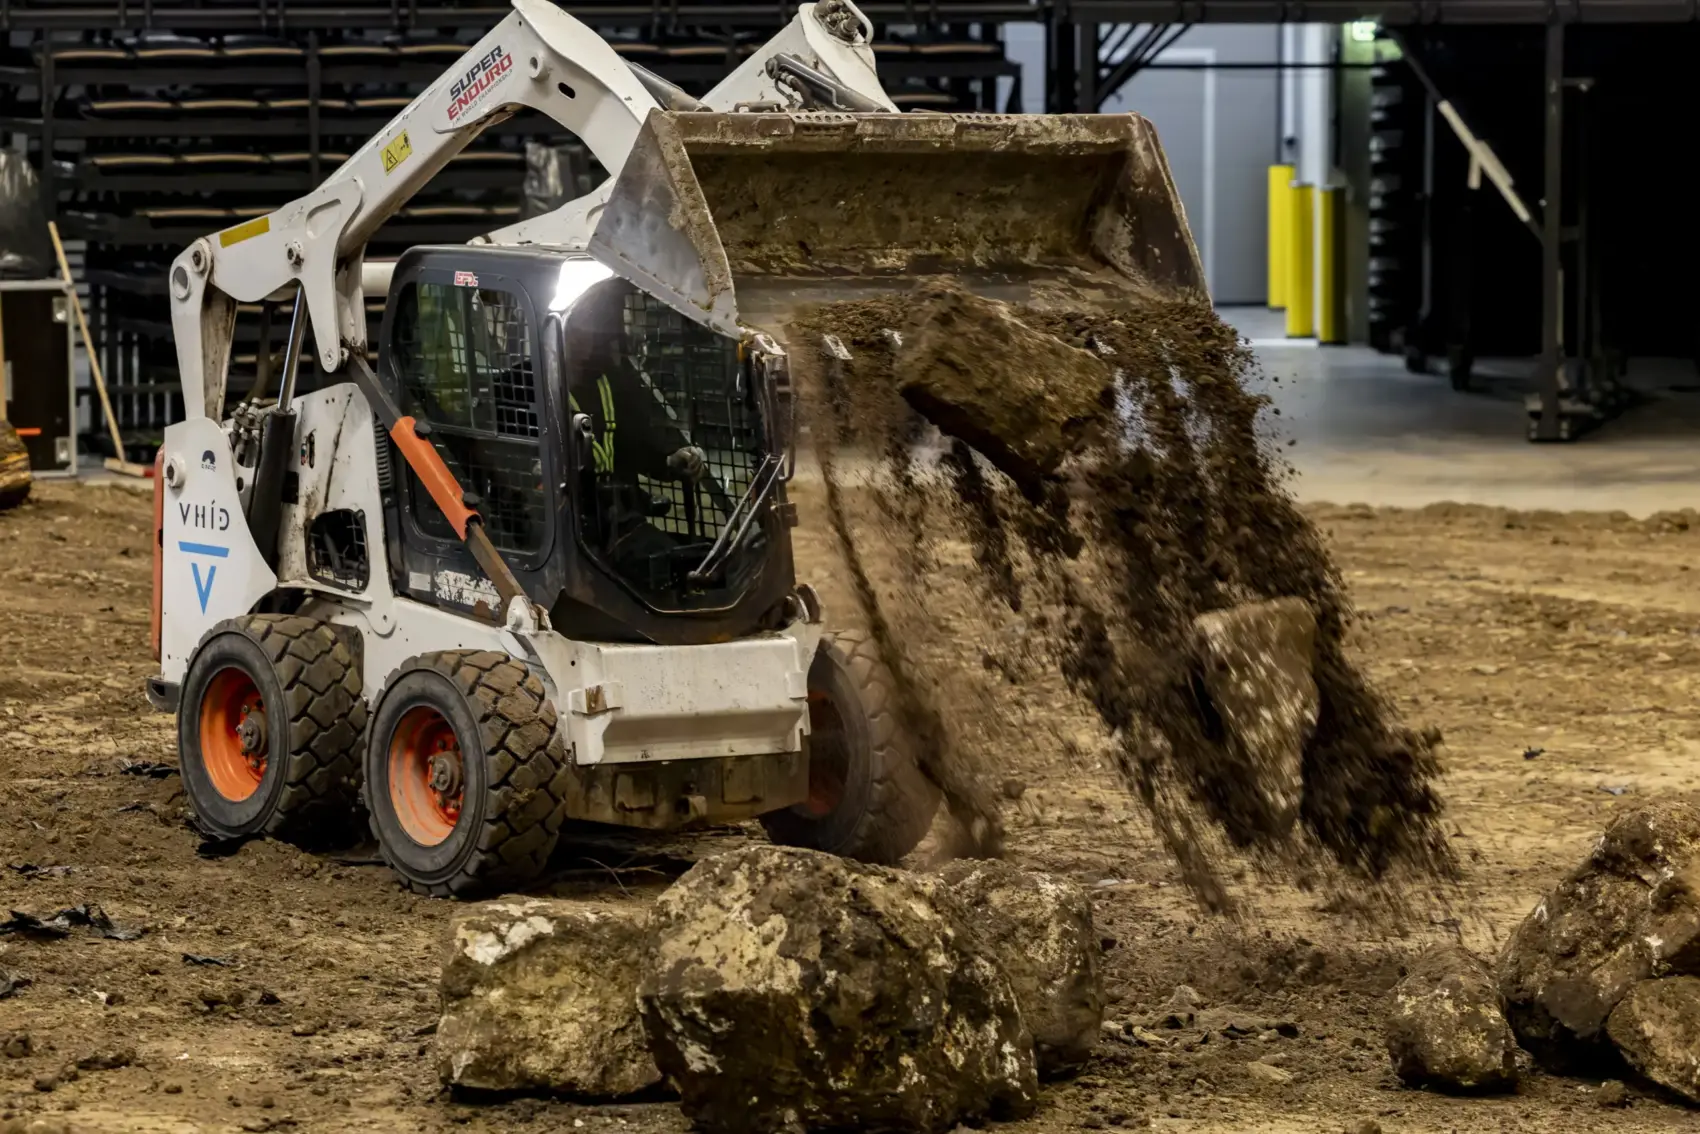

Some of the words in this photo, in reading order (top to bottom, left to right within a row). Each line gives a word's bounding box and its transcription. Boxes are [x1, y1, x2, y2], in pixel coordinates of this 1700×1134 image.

[447, 53, 513, 120] ENDURO
[450, 45, 503, 101] SUPER
[461, 100, 478, 117] WORLD
